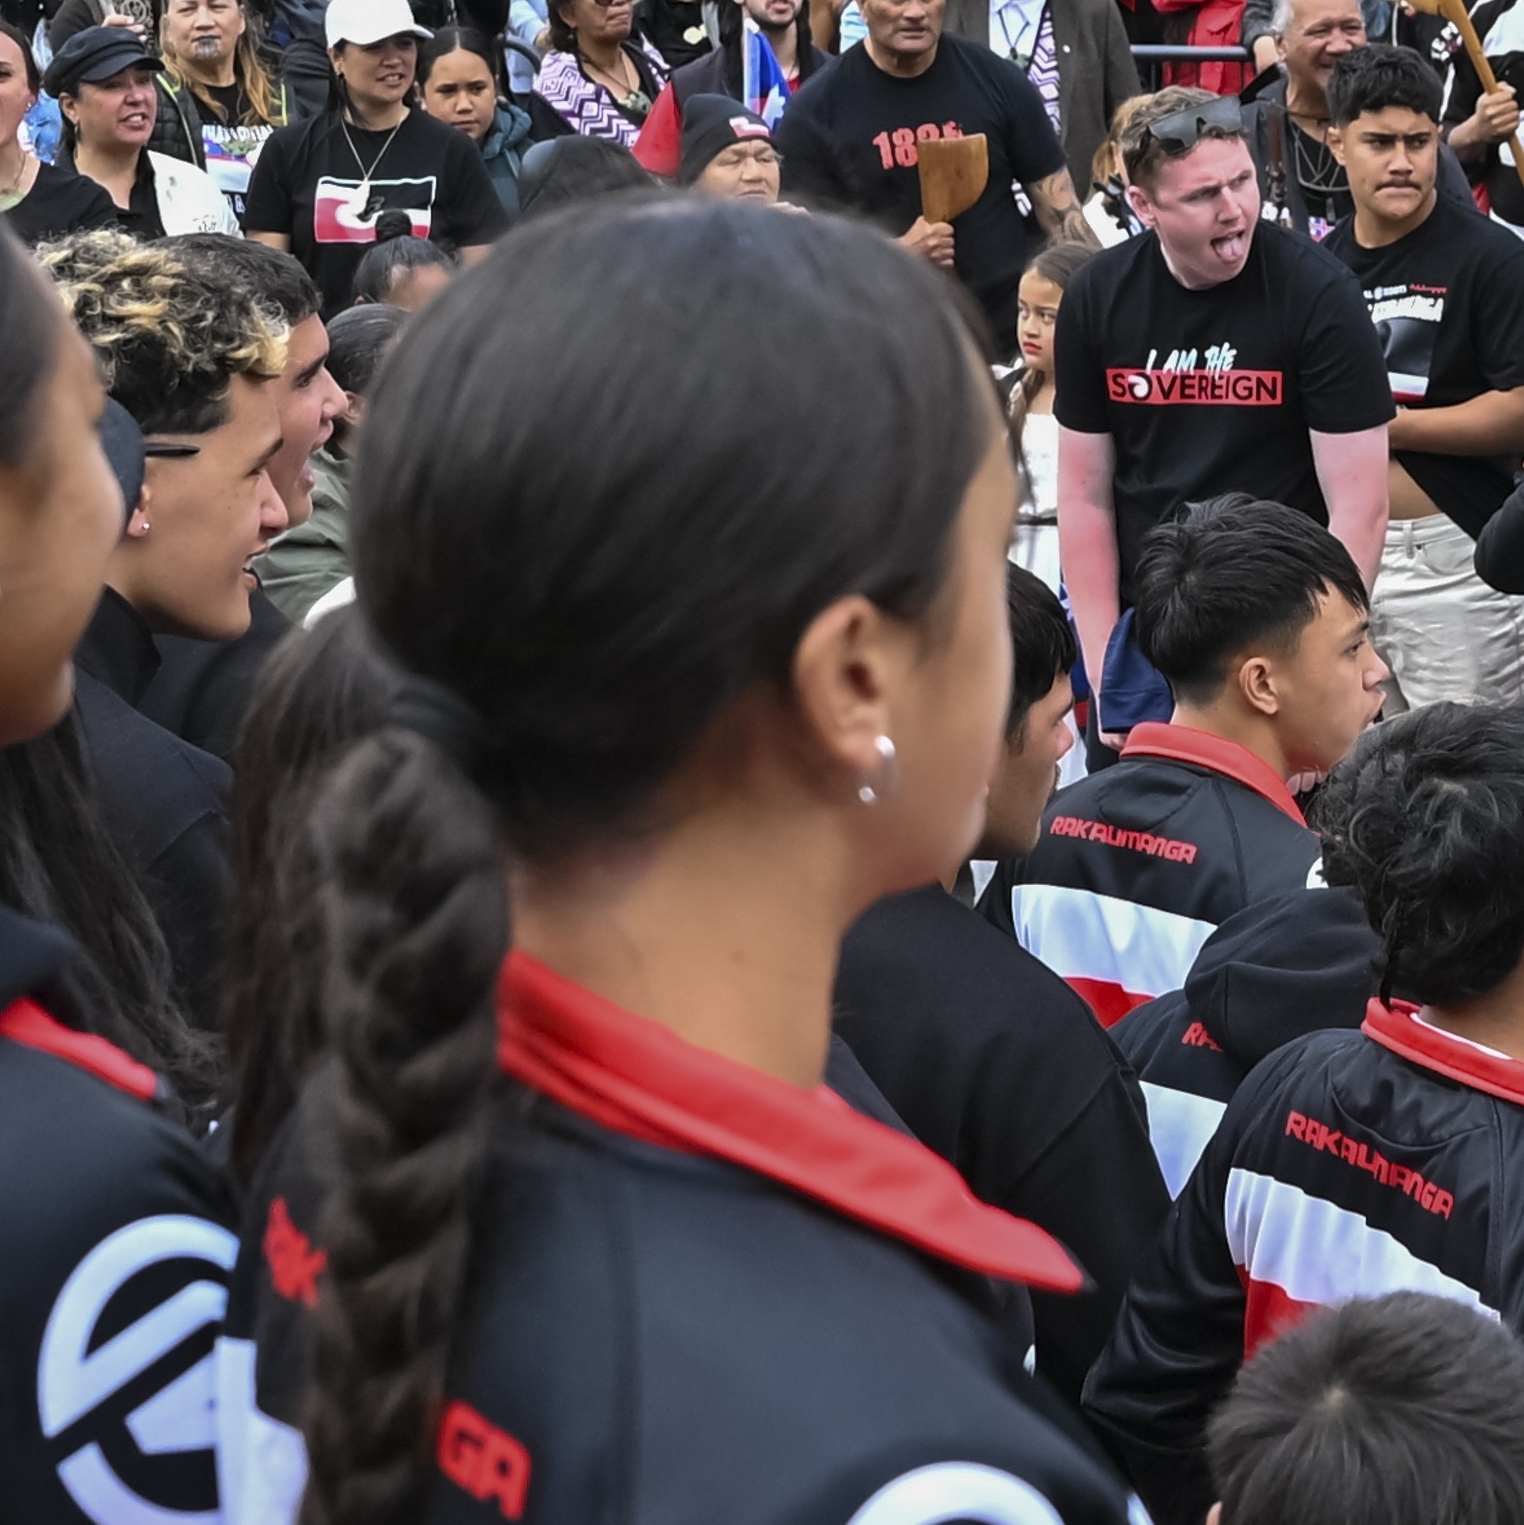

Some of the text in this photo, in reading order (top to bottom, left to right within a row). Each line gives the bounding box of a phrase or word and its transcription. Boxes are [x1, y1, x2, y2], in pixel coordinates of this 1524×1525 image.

[1146, 341, 1237, 380] I AM THE
[1111, 372, 1278, 403] SOVEREIGN
[1050, 815, 1198, 865] RAKAUMANGA
[1284, 1109, 1454, 1220] RAKAUMANGA
